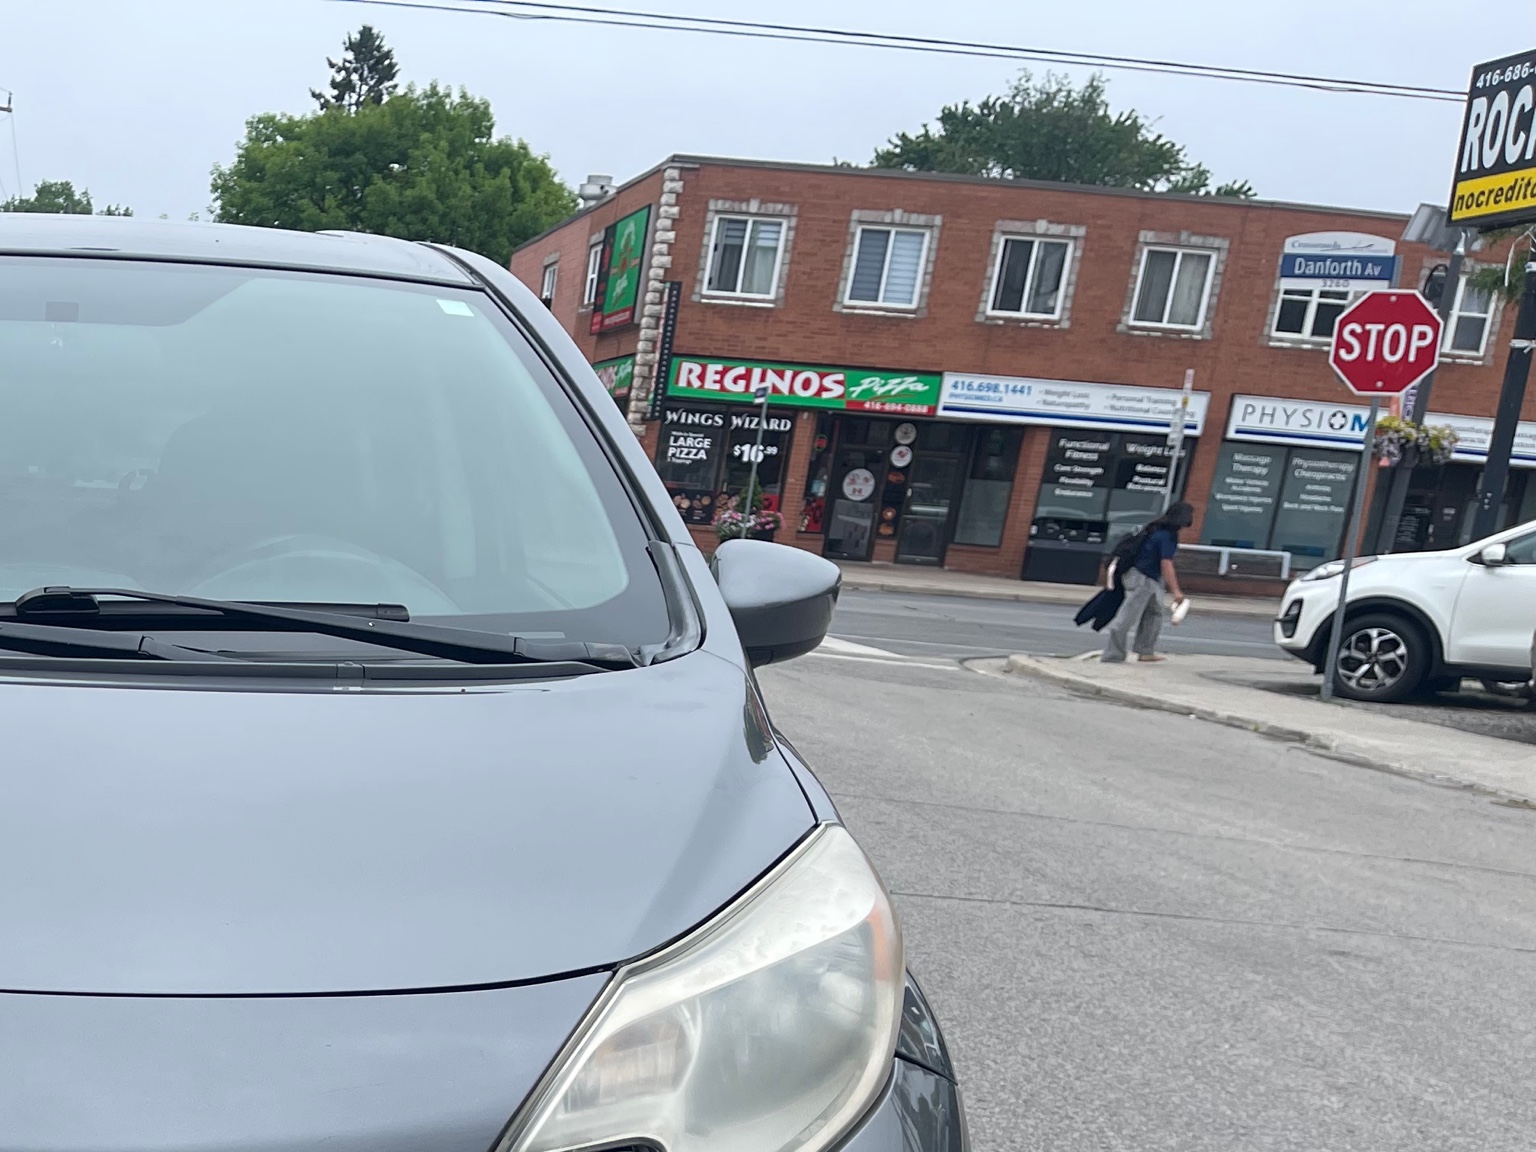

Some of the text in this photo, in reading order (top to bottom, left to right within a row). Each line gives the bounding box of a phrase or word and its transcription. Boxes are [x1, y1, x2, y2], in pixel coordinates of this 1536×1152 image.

[1476, 62, 1536, 89] 416-686-
[1294, 257, 1382, 276] Danforth Av
[1338, 322, 1434, 363] STOP
[677, 361, 845, 398] REGINOS
[664, 408, 792, 431] WINGS WIZARD
[667, 447, 707, 460] PIZZA
[669, 436, 712, 449] LARGE
